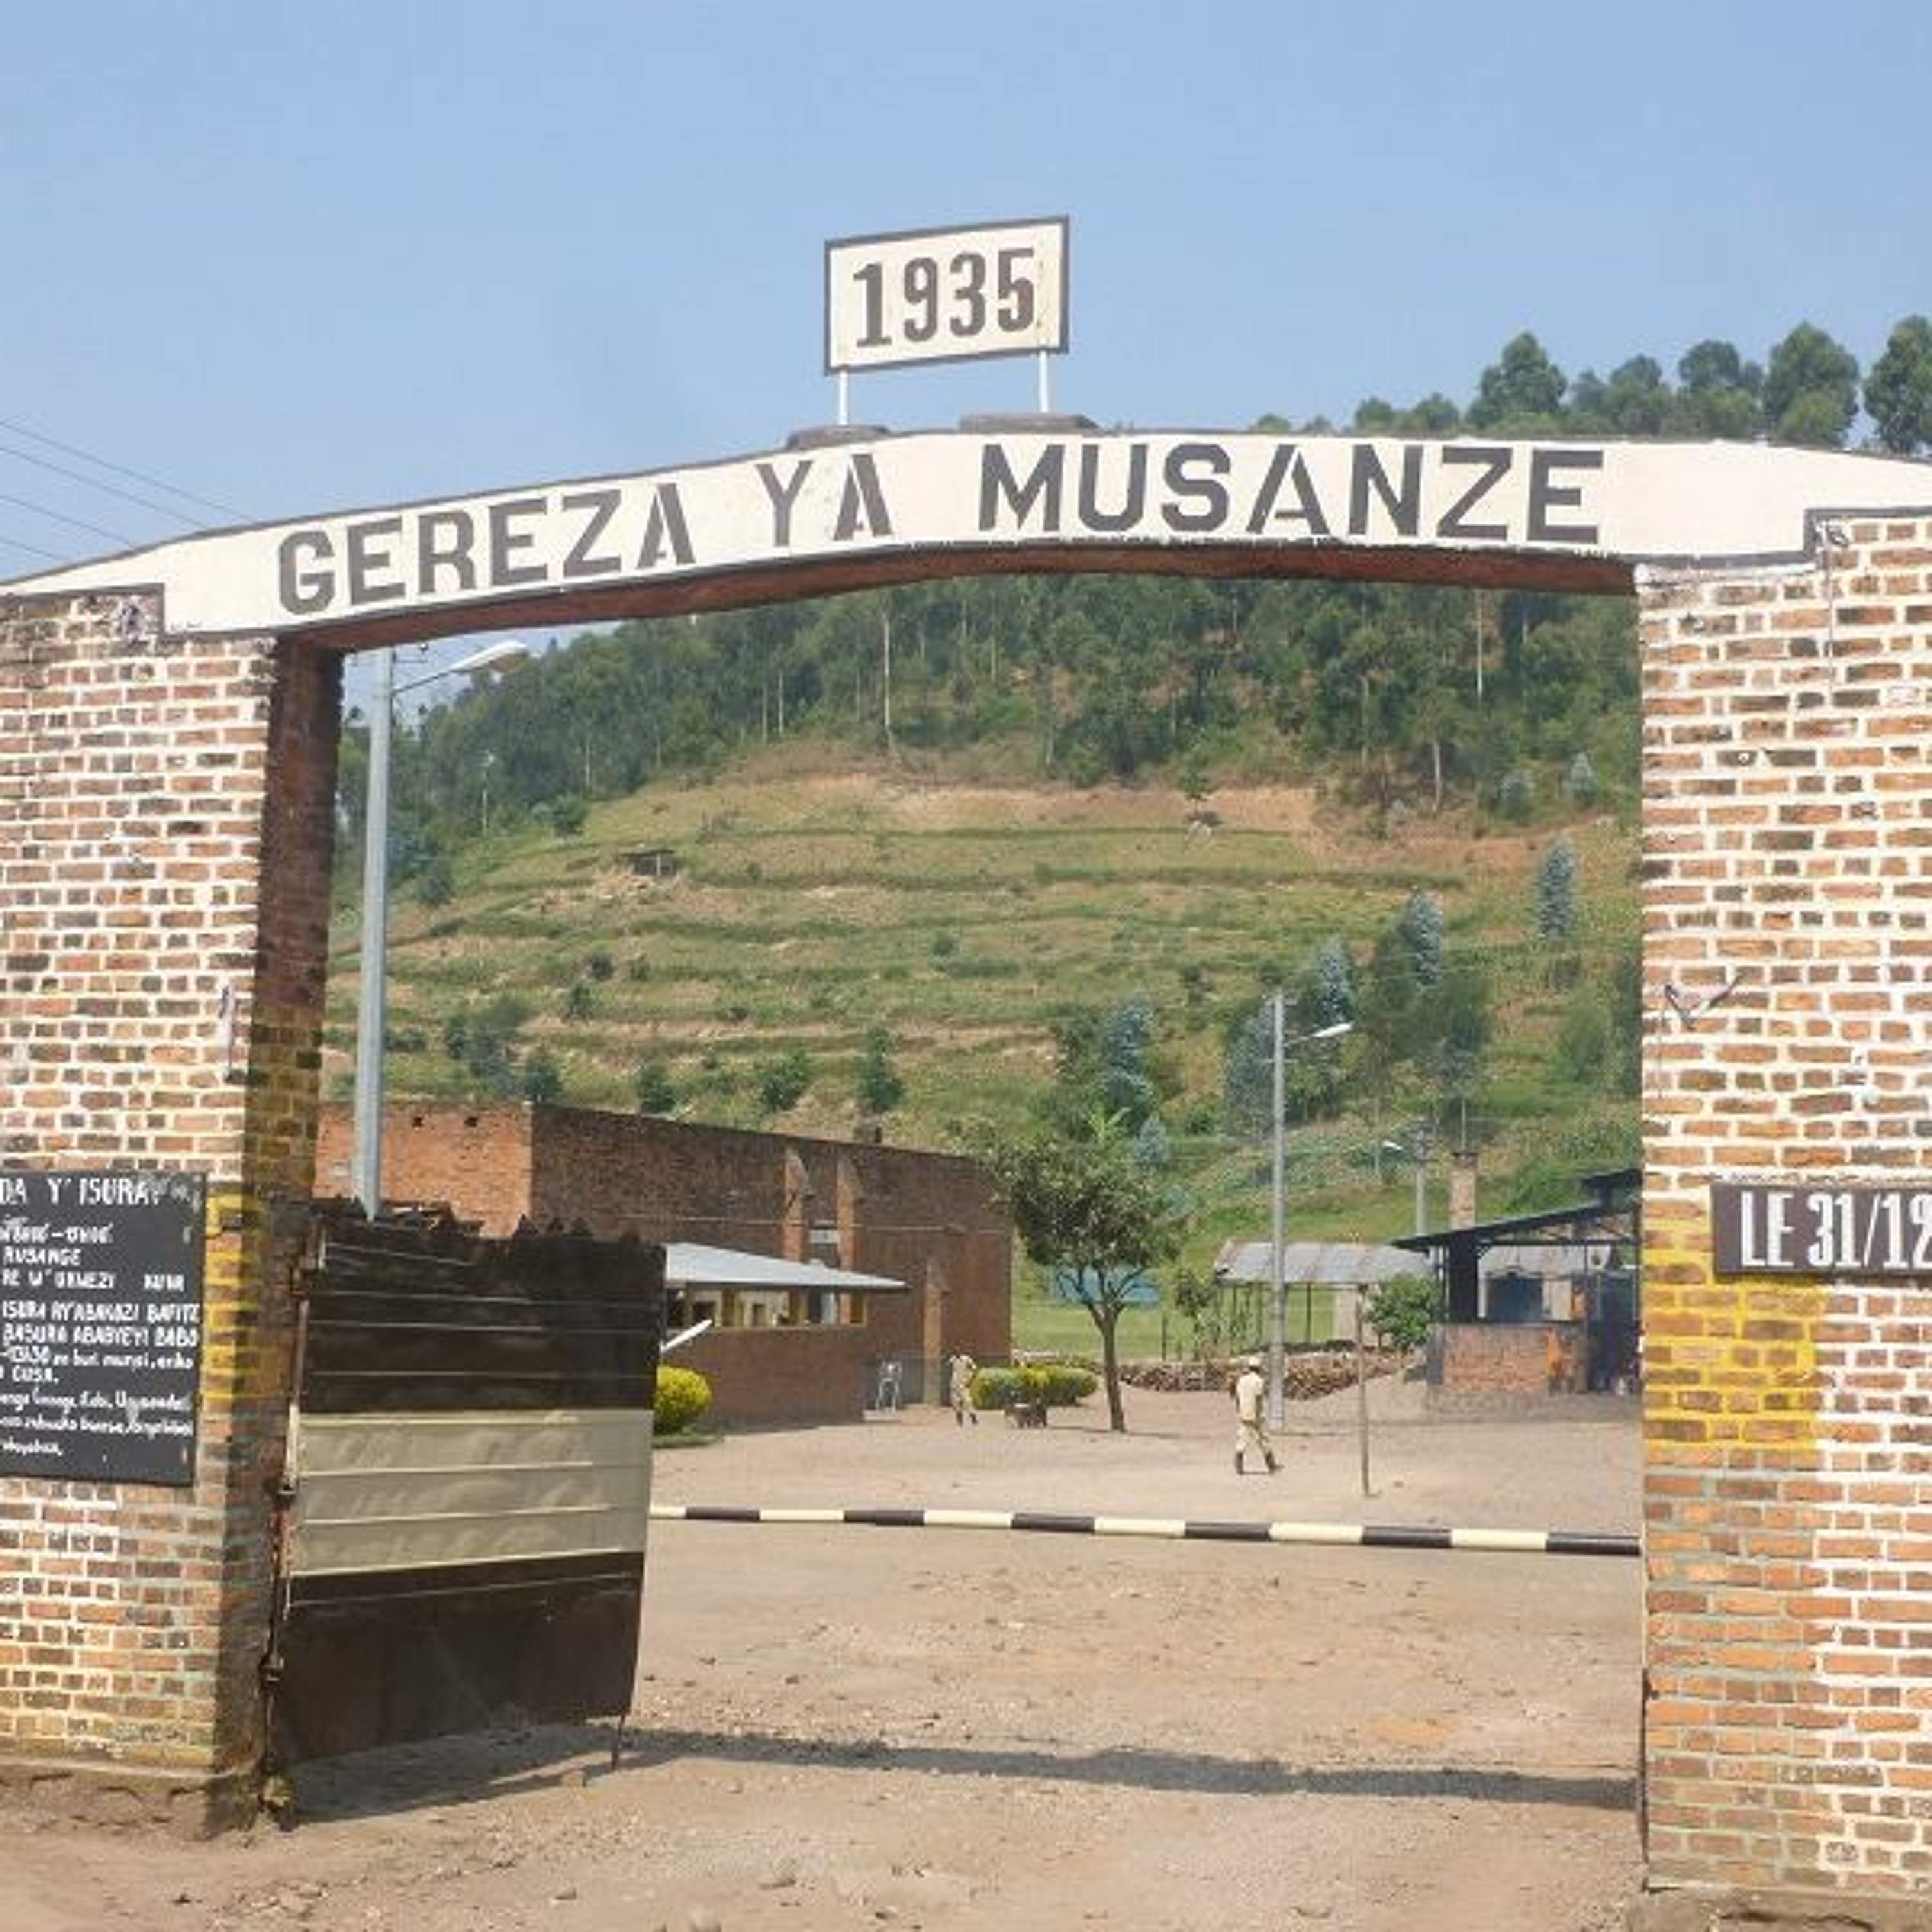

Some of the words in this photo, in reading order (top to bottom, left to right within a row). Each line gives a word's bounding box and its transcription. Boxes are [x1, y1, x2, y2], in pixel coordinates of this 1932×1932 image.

[853, 247, 1034, 348] 1935
[278, 482, 696, 616] GEREZA
[753, 453, 893, 547] YA
[978, 442, 1604, 544] MUSANZE
[1741, 1190, 1795, 1267] LE
